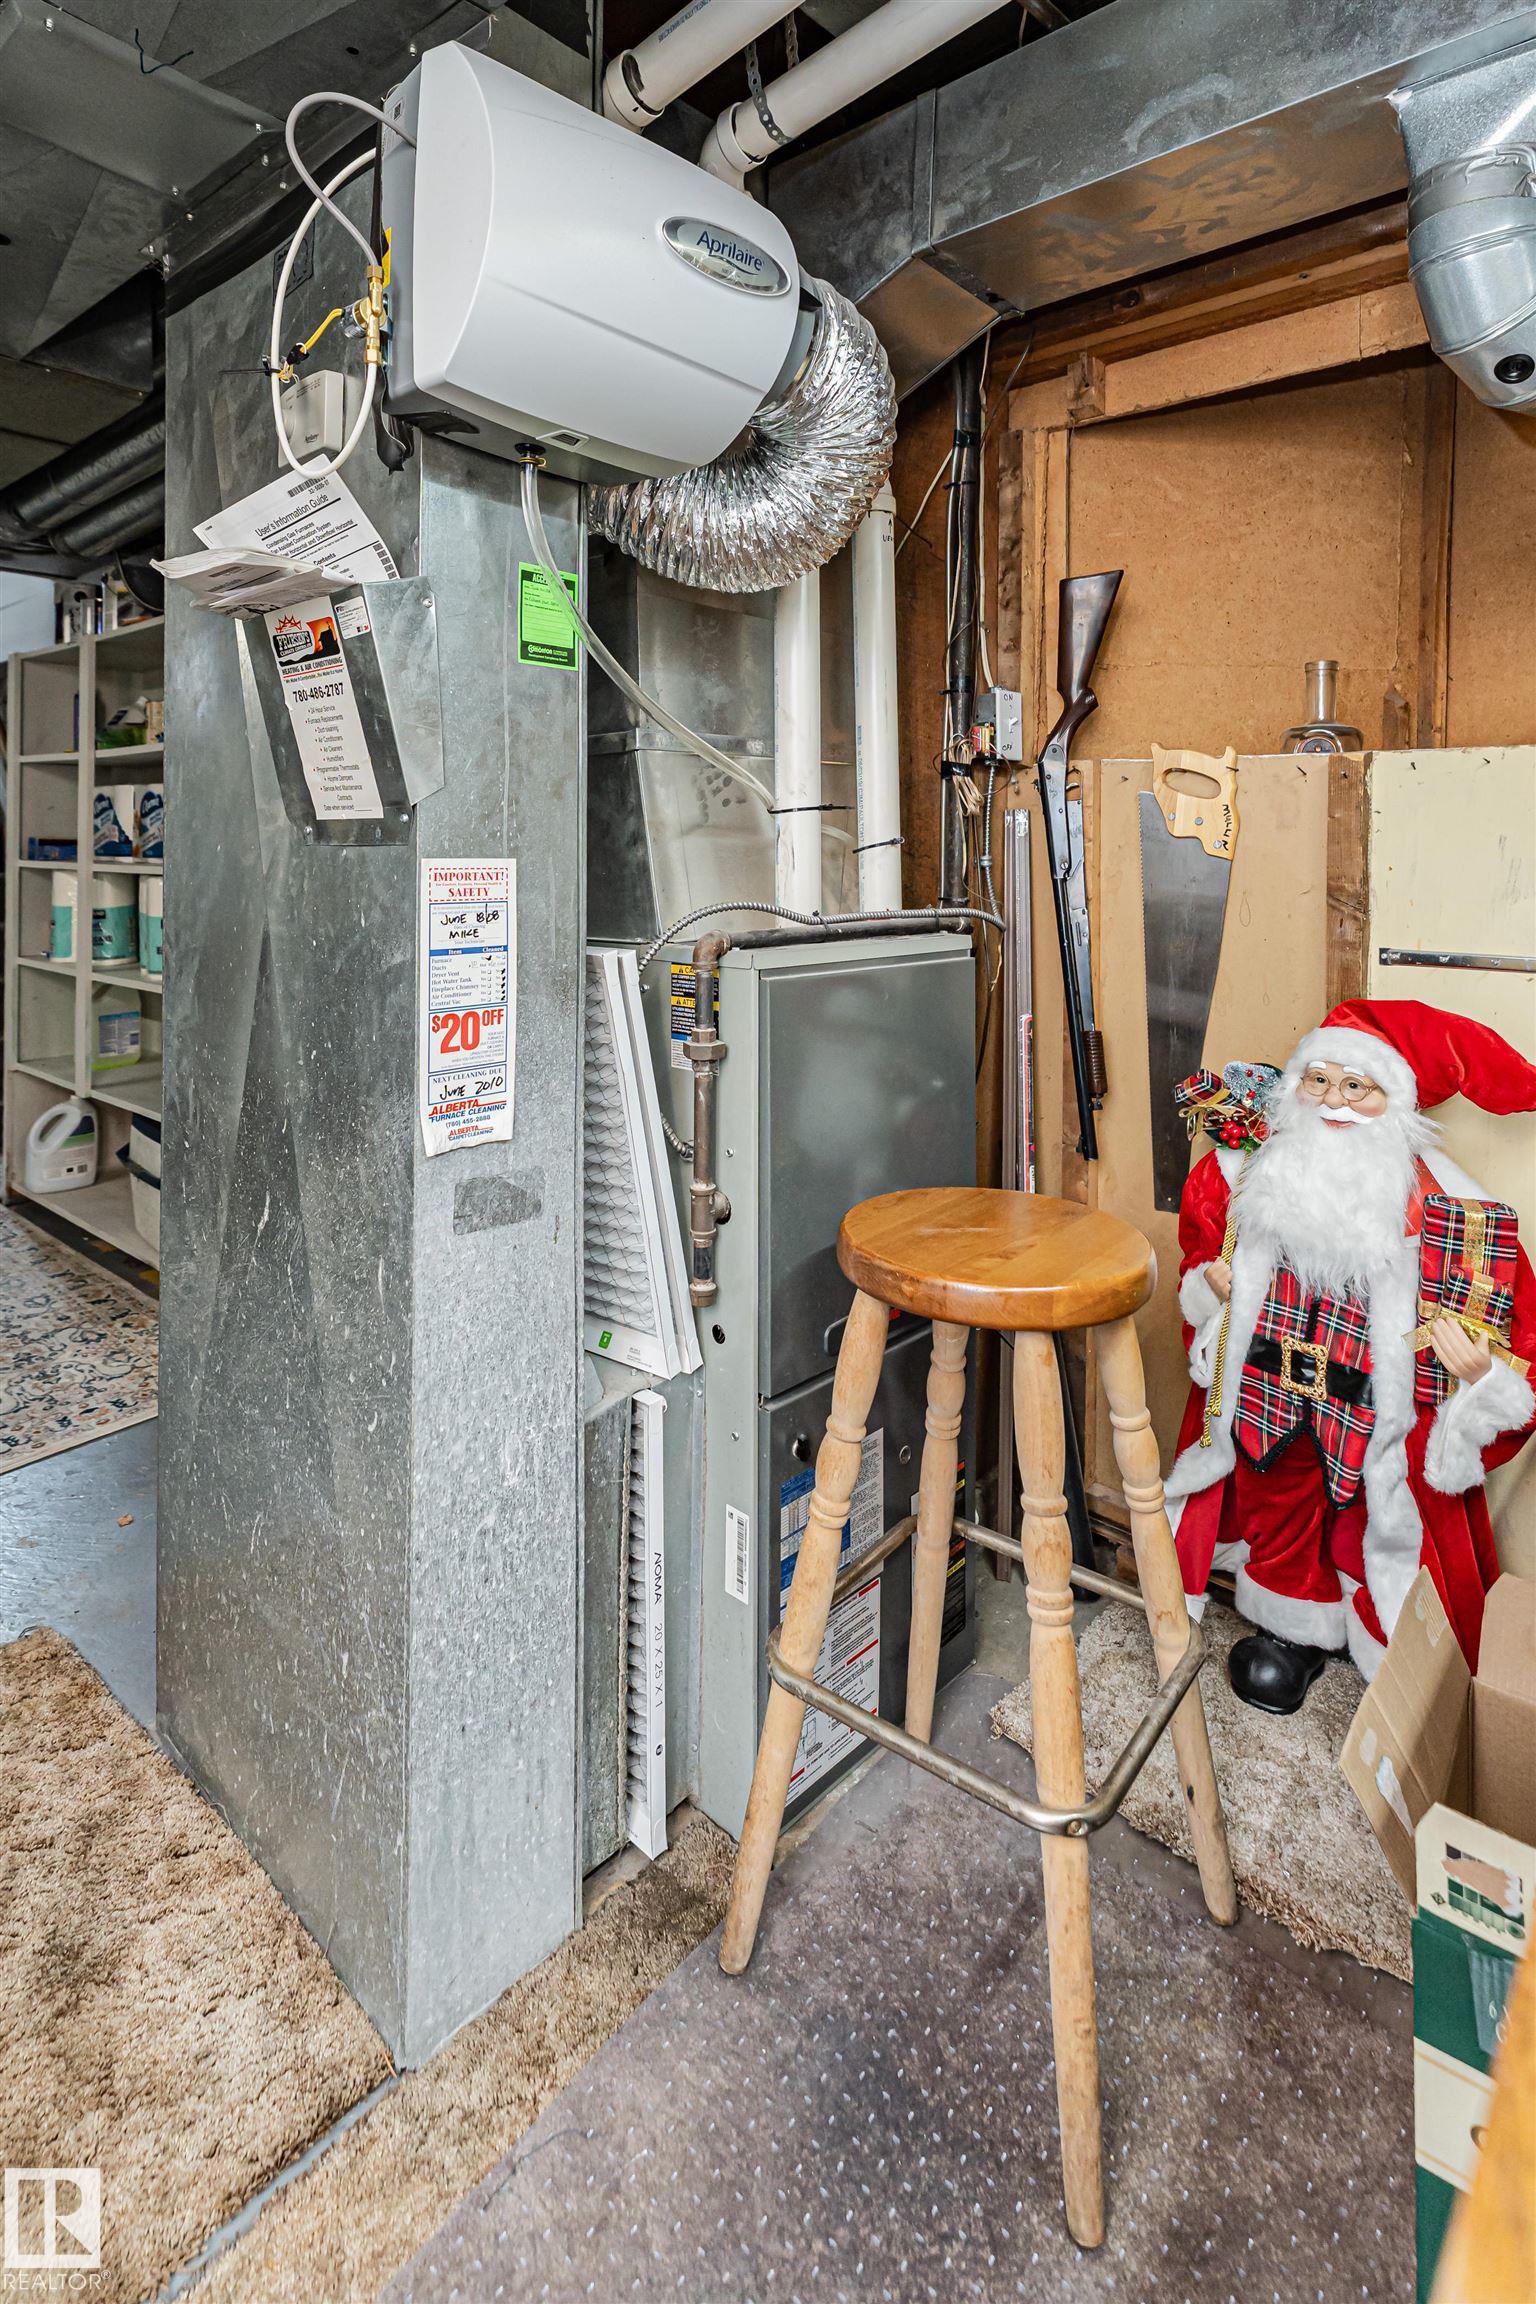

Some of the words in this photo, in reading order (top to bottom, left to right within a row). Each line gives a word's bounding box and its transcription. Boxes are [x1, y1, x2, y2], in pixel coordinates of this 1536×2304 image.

[696, 230, 763, 271] Aprilaire
[255, 520, 276, 538] User's
[274, 502, 311, 528] Information
[310, 494, 329, 509] Guide
[295, 522, 314, 535] Furnaces
[282, 666, 300, 675] HEATING
[312, 656, 343, 669] CONDITIONING
[292, 682, 344, 702] 780-486-2787
[1002, 743, 1012, 751] OFF
[434, 872, 504, 882] IMPORTANT!
[448, 887, 490, 897] SAFETY
[432, 1010, 480, 1054] $20
[482, 1008, 504, 1026] OFF
[433, 1076, 452, 1084] NEXT
[453, 1070, 487, 1082] CLEANING
[489, 1067, 503, 1076] DUE
[475, 1076, 504, 1095] 2010
[428, 1110, 466, 1123] FURNACE
[468, 1104, 506, 1116] CLEANING
[429, 1099, 480, 1116] ALBERTA
[446, 1120, 460, 1128] (780)
[448, 1125, 480, 1136] ALBERTA
[467, 1129, 494, 1138] CLEANING
[654, 1552, 663, 1605] NOMA
[654, 1622, 663, 1641] 20
[655, 1646, 663, 1658] X
[654, 1660, 663, 1679] 25
[655, 1682, 663, 1695] X
